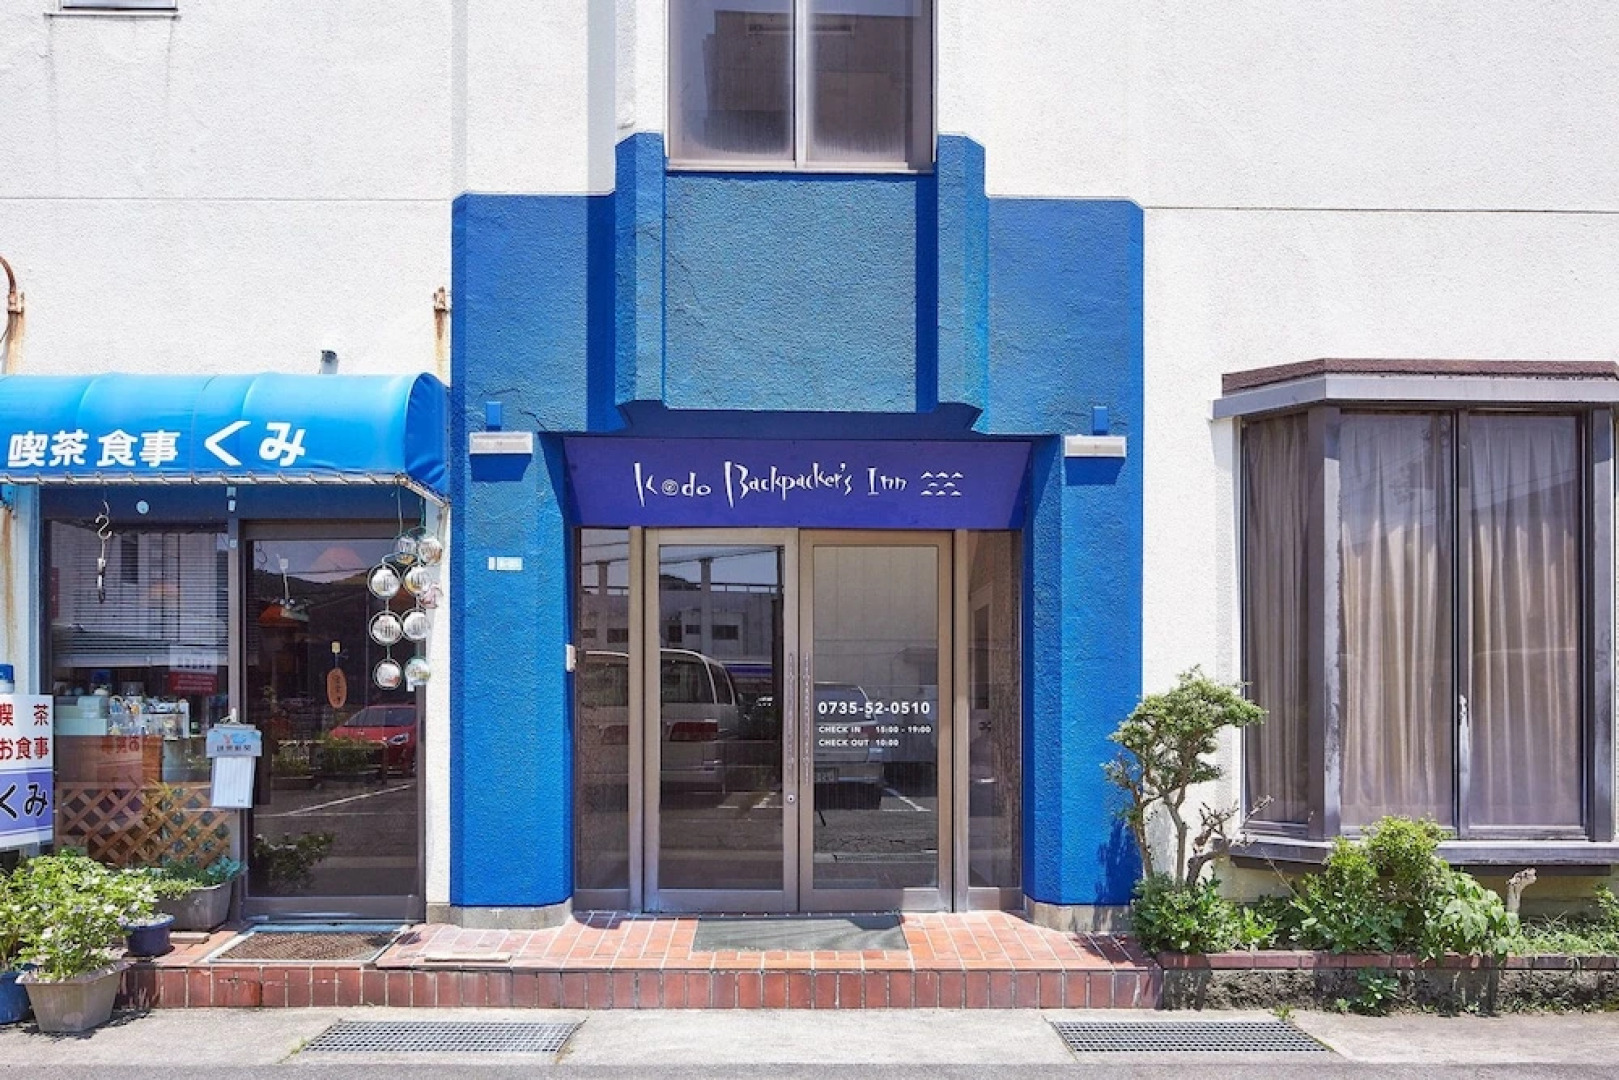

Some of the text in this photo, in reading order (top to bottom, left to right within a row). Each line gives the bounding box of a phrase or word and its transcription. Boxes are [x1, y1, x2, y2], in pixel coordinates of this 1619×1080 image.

[7, 420, 306, 467] 喫茶 食事 くみ
[633, 461, 907, 508] Kodo Backpacker's Inn
[818, 701, 930, 715] 0735-52-0510
[0, 736, 49, 760] お食事
[818, 739, 899, 747] CHECK OUT 10:00
[0, 783, 49, 820] くみ
